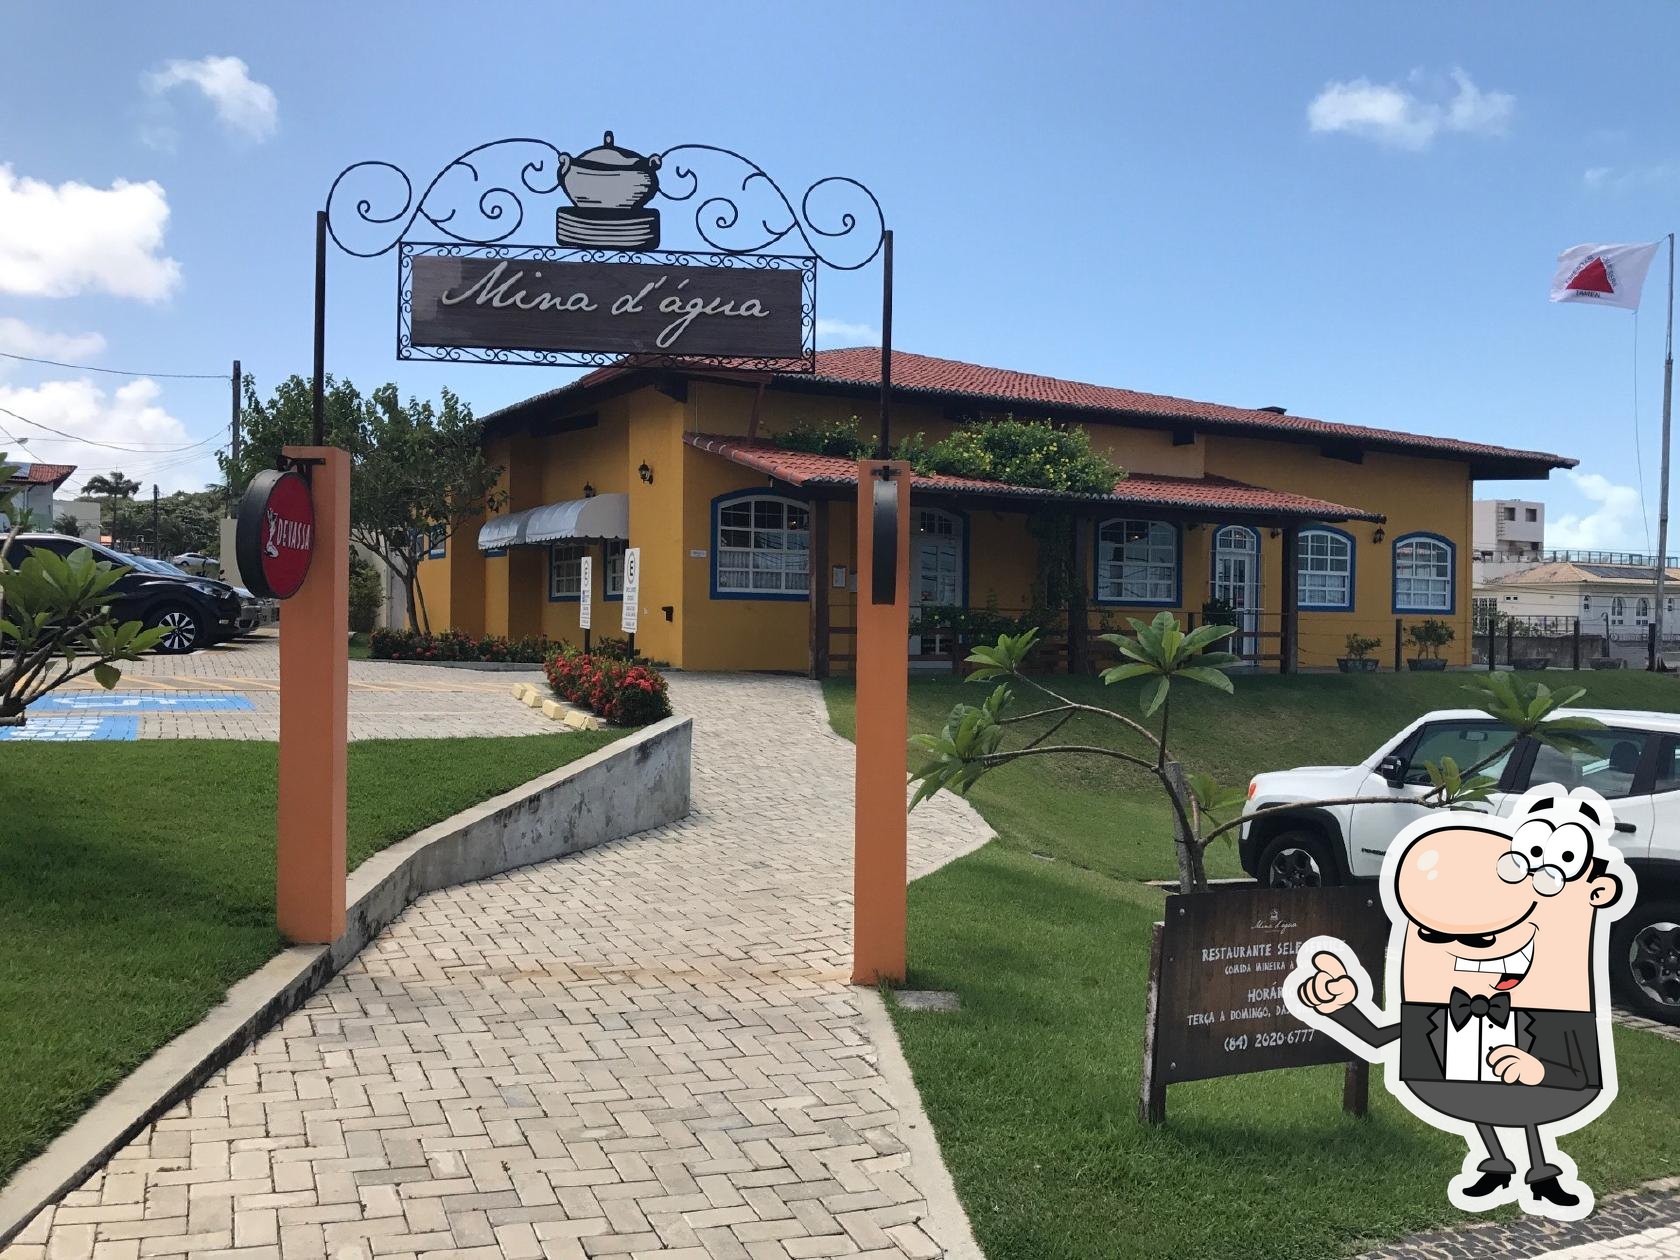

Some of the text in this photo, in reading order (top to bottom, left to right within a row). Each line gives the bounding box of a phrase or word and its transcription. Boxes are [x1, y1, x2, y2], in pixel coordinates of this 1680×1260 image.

[442, 260, 770, 348] Mina d'água
[276, 518, 311, 550] DEVASSA
[1202, 943, 1272, 962] RESTAURANTE
[1224, 962, 1251, 975] COMIDA
[1255, 961, 1286, 972] MINEIRA
[1186, 1011, 1215, 1026] TERÇA
[1219, 1011, 1225, 1022] A
[1230, 1006, 1271, 1020] DOMINGO,
[1224, 1034, 1248, 1052] (84)
